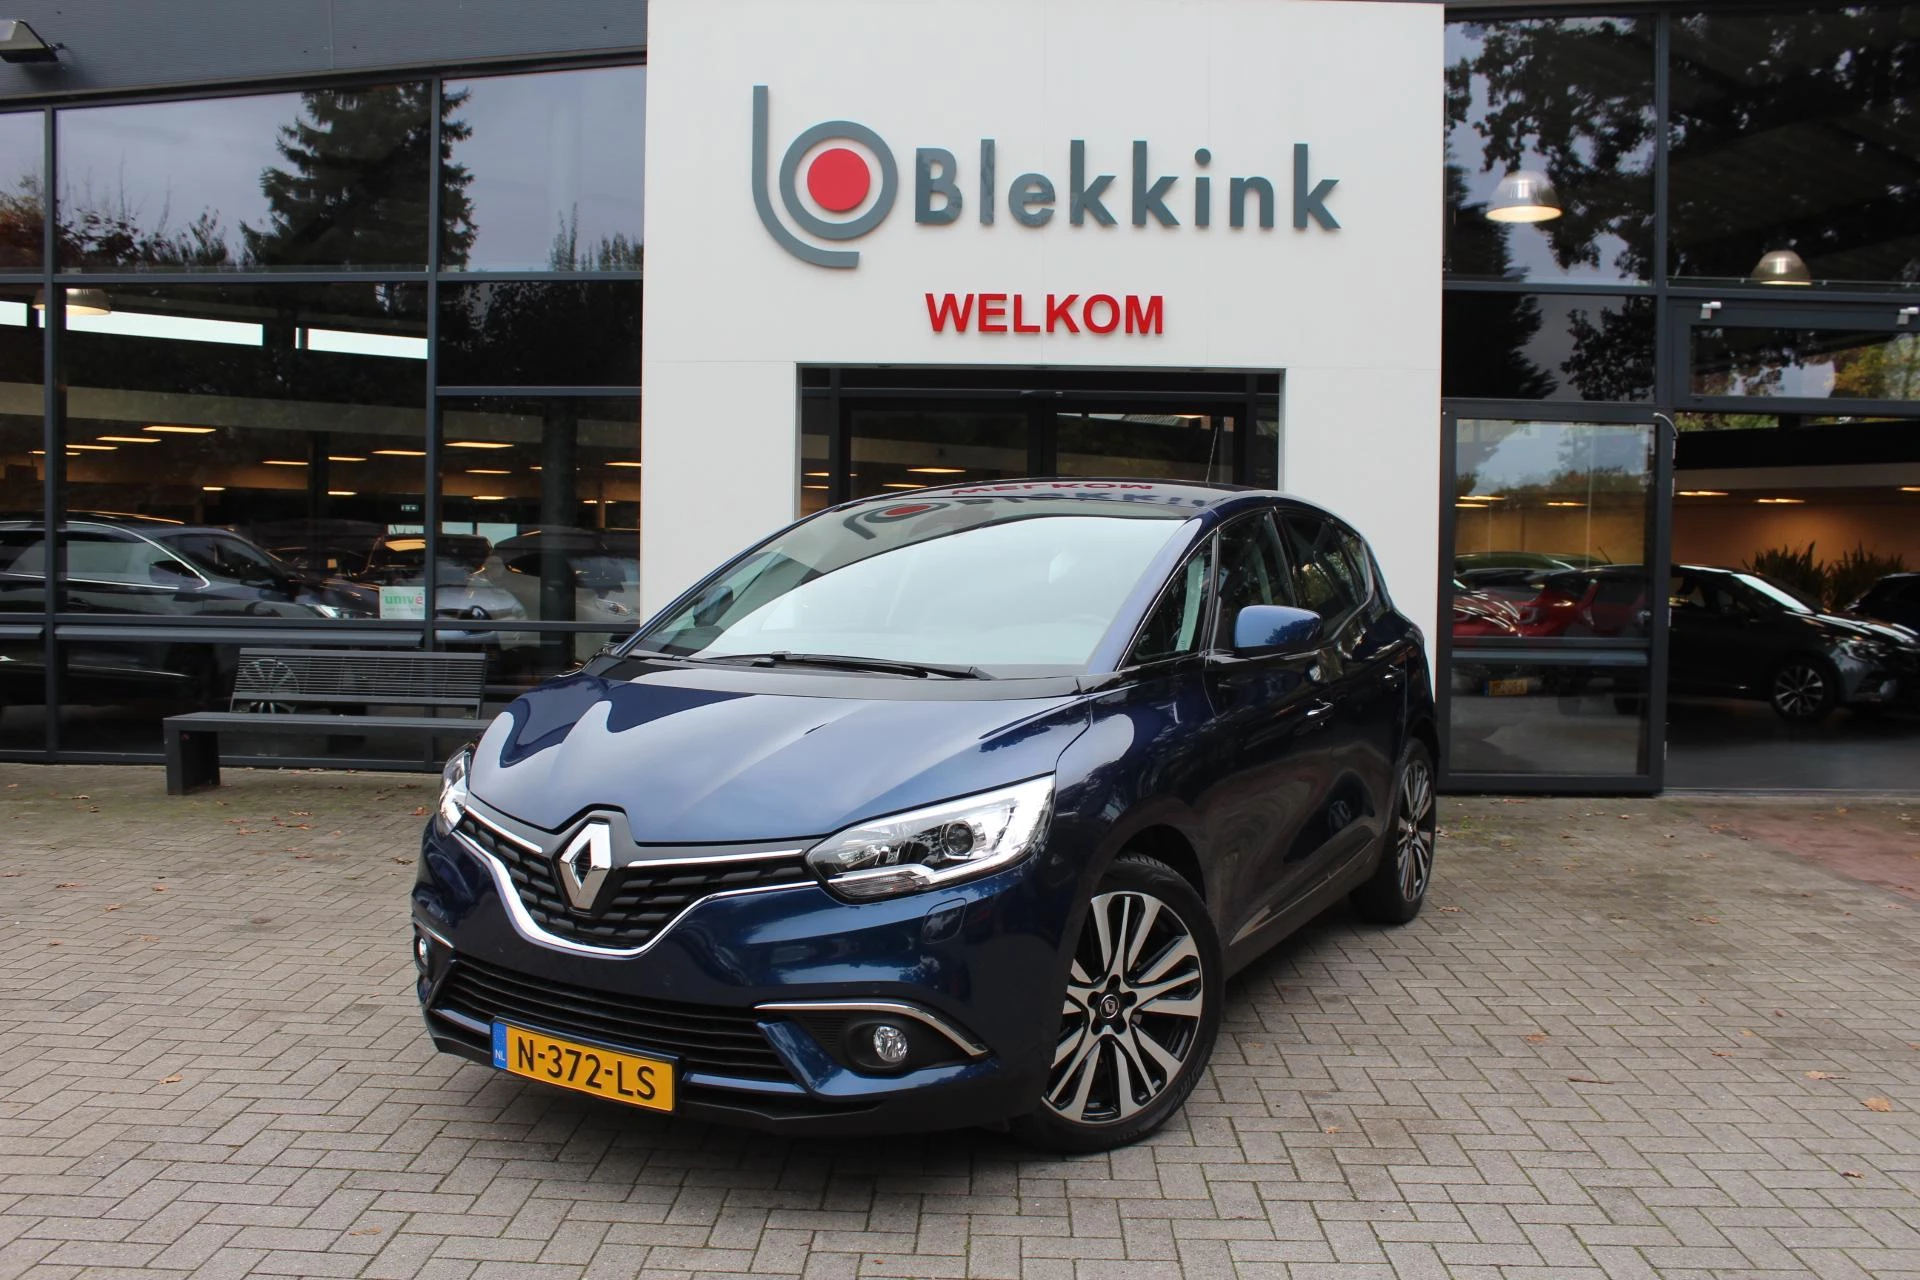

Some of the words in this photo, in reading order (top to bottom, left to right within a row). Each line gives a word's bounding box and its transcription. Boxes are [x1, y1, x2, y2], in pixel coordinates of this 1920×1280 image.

[915, 138, 1341, 230] Blekkink
[925, 292, 1164, 335] WELKOM
[495, 1050, 506, 1062] NL
[517, 1036, 656, 1100] N-372-LS
